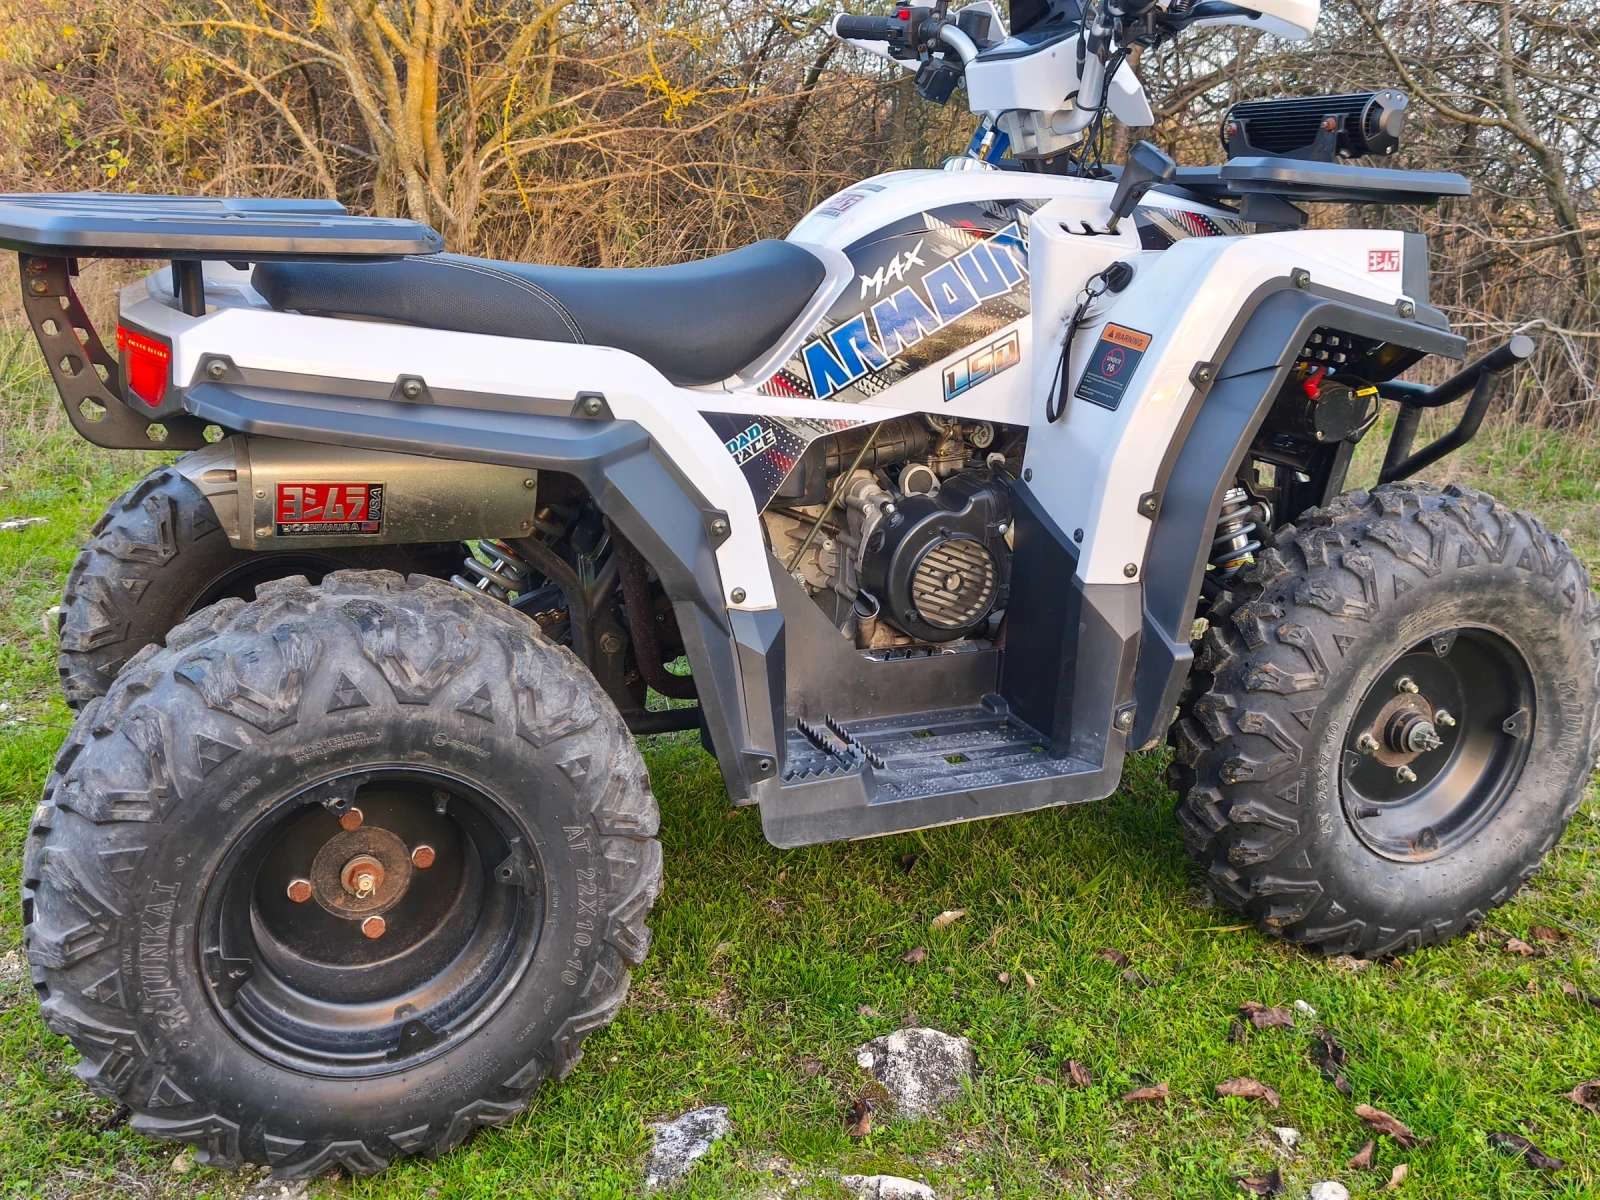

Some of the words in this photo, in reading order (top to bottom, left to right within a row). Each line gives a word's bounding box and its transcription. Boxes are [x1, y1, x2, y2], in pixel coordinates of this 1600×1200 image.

[858, 237, 926, 300] MAX
[1369, 251, 1399, 272] ヨシムラ
[1114, 331, 1144, 347] WARNING
[1106, 355, 1122, 365] UNDER
[1106, 362, 1116, 372] 16
[724, 423, 763, 456] OAD
[282, 486, 366, 521] ヨシムラ
[368, 487, 382, 520] USA
[281, 522, 361, 533] YOSHIMURA
[216, 776, 262, 812] NYLON
[562, 826, 592, 853] AT
[140, 880, 182, 1001] JUNKAI
[561, 868, 597, 986] 22X10-10
